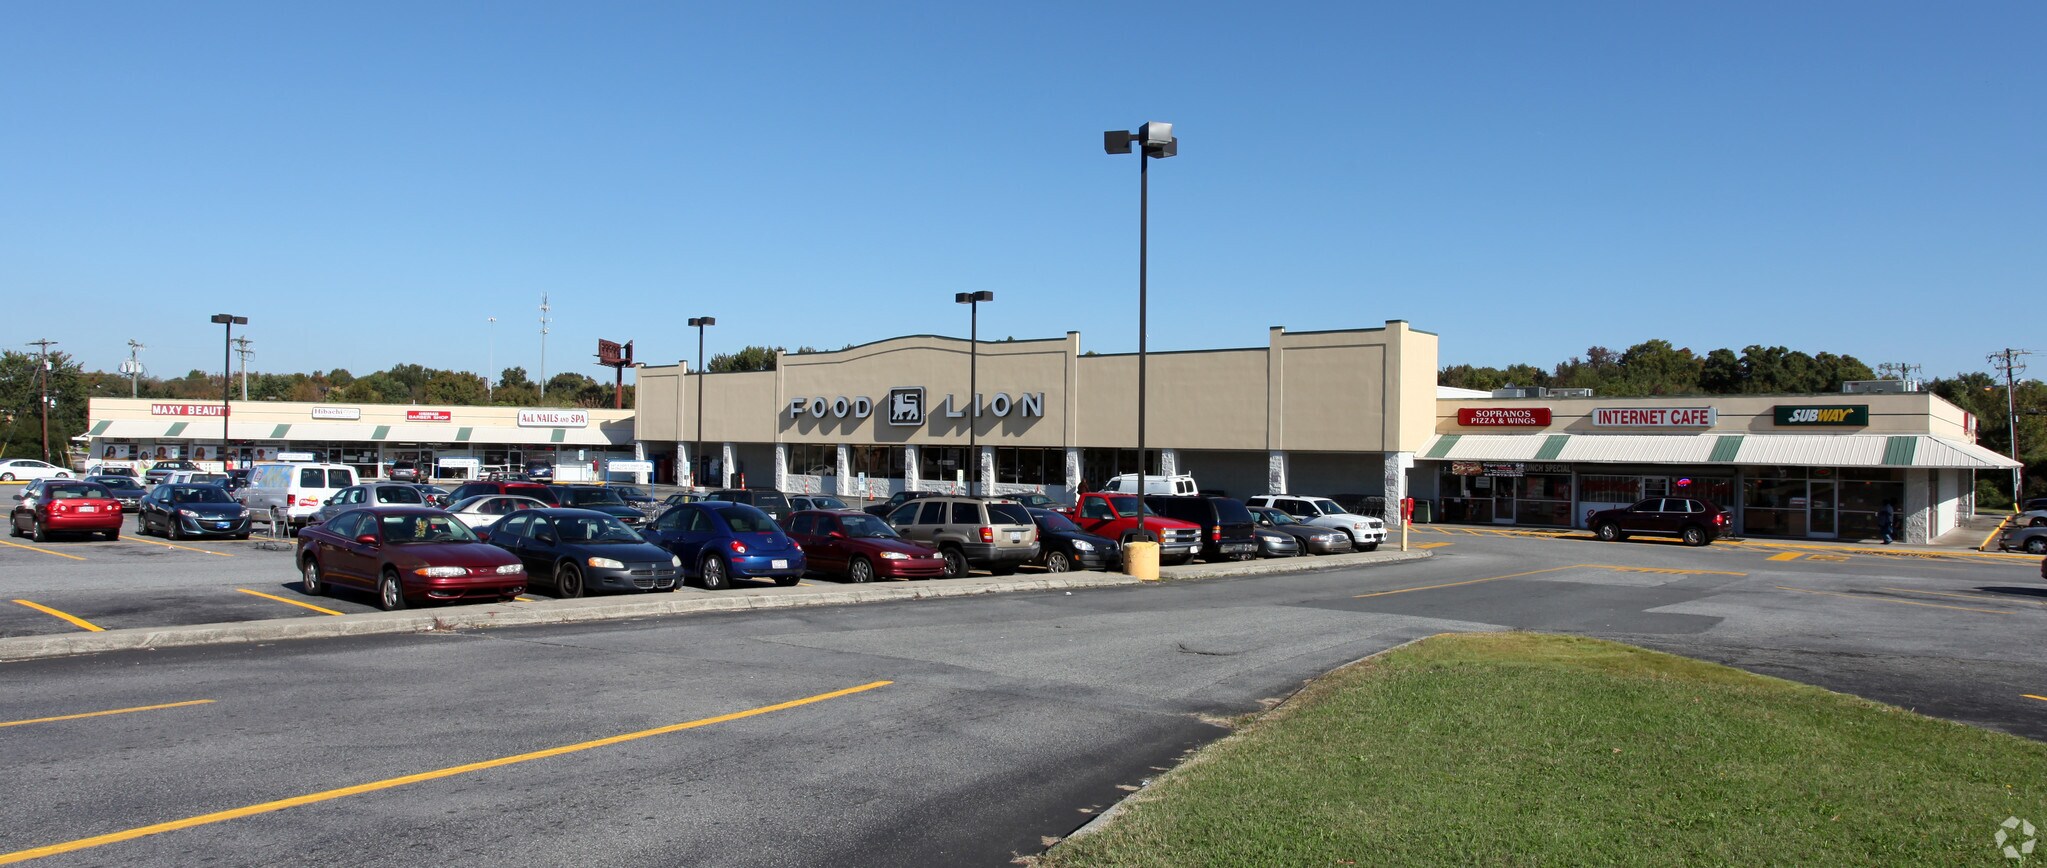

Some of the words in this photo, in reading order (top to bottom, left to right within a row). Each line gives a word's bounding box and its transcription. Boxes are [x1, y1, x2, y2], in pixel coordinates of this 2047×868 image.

[152, 405, 182, 415] MAXY
[790, 396, 873, 419] FOOD
[945, 392, 1045, 418] LION
[522, 413, 535, 423] A&L
[536, 413, 559, 423] NAILS
[570, 414, 585, 423] SPA
[1598, 410, 1667, 424] INTERNET
[1670, 410, 1709, 424] CAFE
[1788, 408, 1854, 423] SUBWAY
[1525, 463, 1544, 473] UNCH
[1544, 463, 1571, 473] SPECIAL
